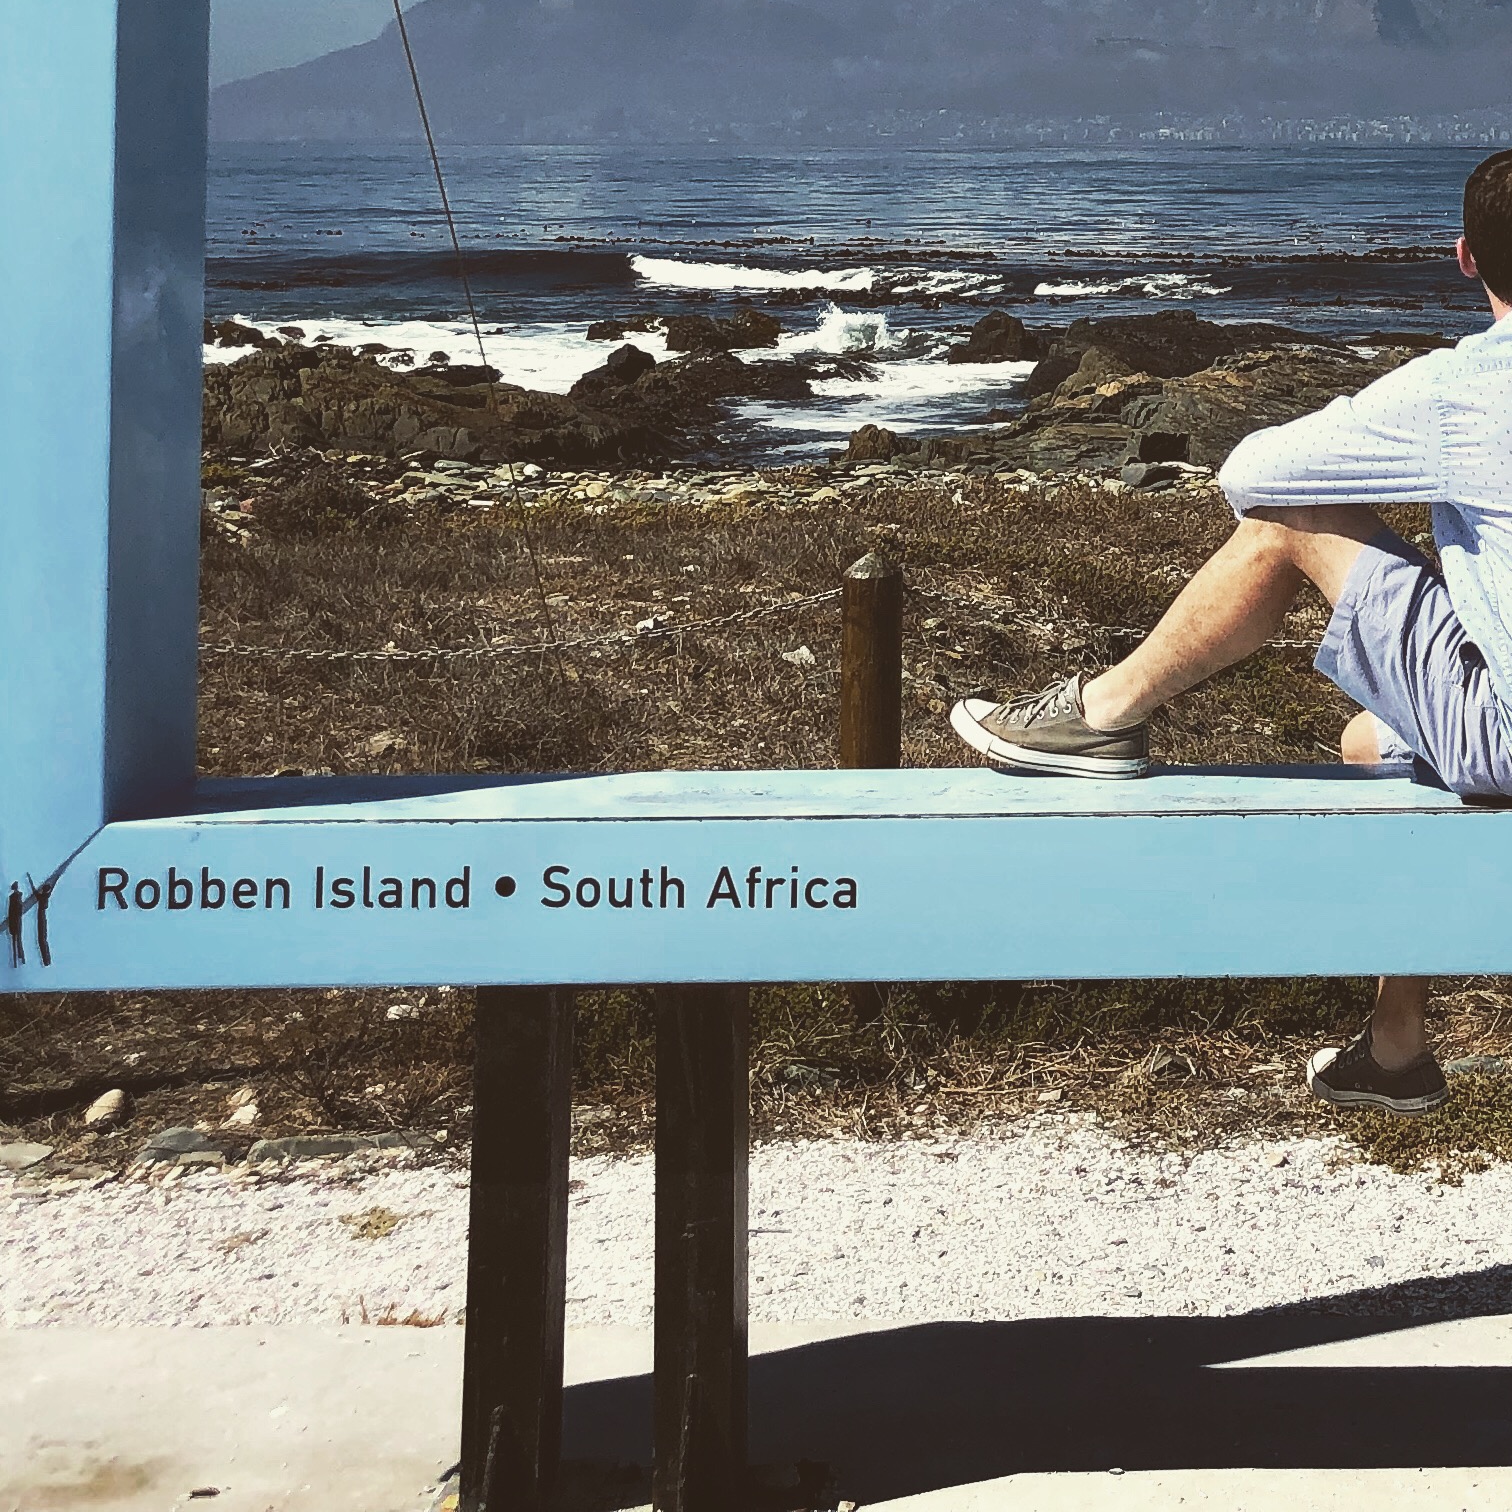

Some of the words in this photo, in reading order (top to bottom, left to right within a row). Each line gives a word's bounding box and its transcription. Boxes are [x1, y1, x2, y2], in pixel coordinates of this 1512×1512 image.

[97, 866, 290, 911] Robben
[315, 865, 471, 910] Island
[540, 865, 685, 909] South
[706, 865, 857, 909] Africa
